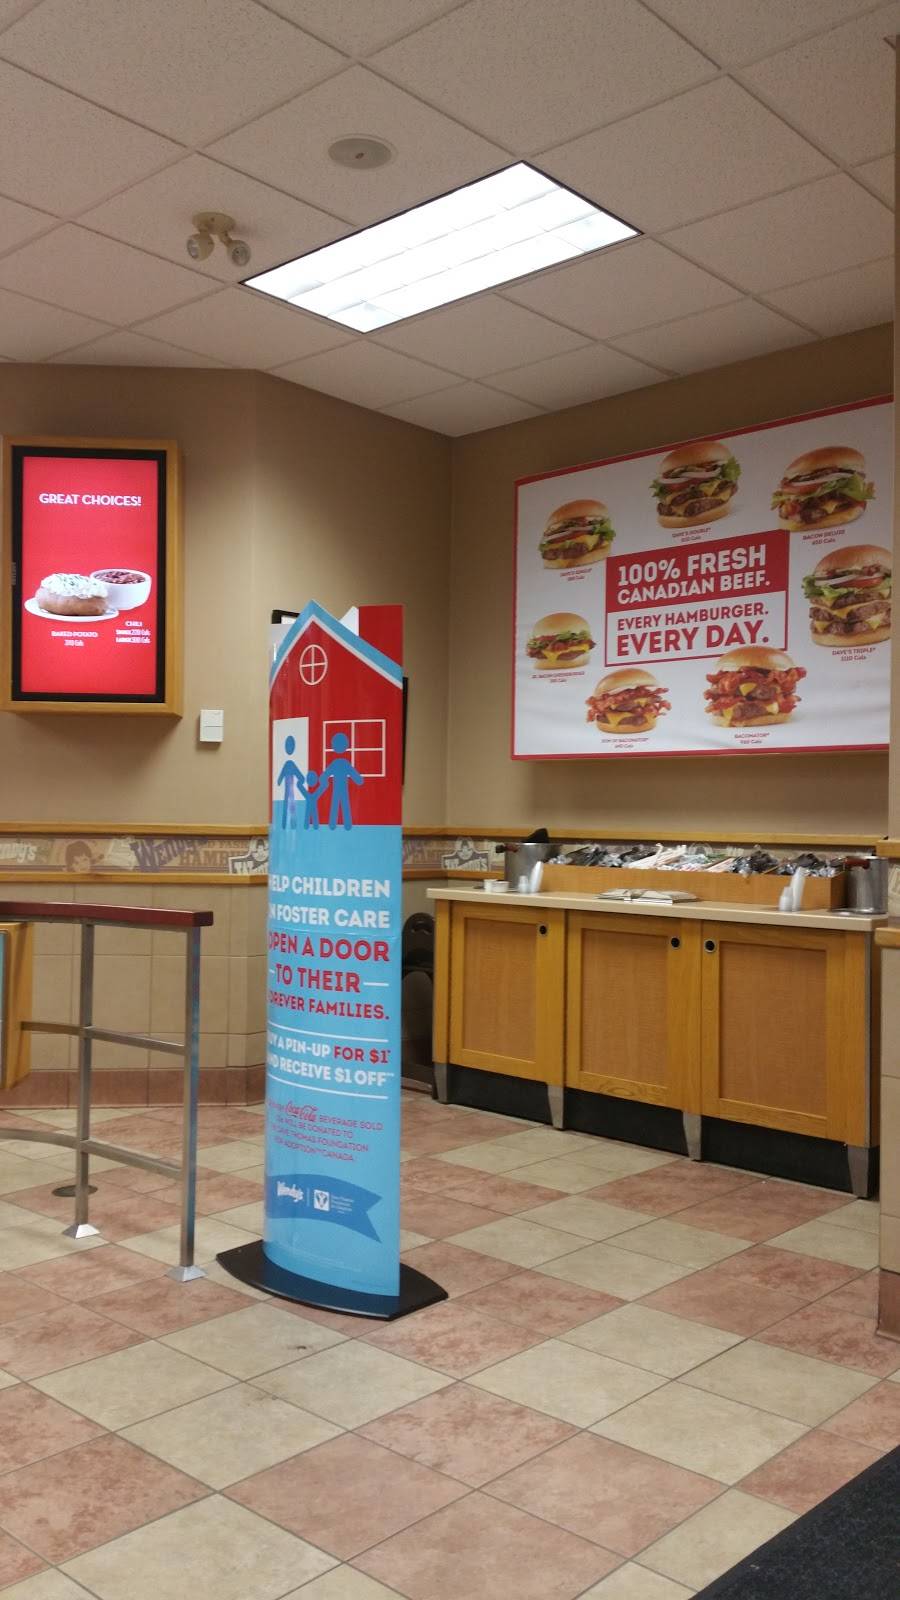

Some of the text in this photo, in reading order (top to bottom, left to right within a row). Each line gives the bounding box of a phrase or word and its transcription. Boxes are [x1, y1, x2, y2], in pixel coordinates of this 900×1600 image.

[39, 493, 142, 507] GREAT CHOICES!
[617, 544, 766, 586] 100% FRESH
[617, 570, 770, 605] CANADIAN BEEF.
[617, 602, 769, 632] EVERY HAMBURGER.
[617, 619, 769, 657] EVERY DAY.
[269, 874, 391, 898] ELP CHILDREN
[277, 904, 330, 926] FOSTER
[334, 909, 390, 929] CARE
[302, 936, 314, 956] A
[319, 937, 390, 962] DOOR
[276, 963, 361, 993] TO THEIR
[308, 998, 390, 1020] FAMILIES.
[277, 1036, 285, 1049] A
[286, 1038, 331, 1057] PIN-UP
[334, 1045, 364, 1062] FOR
[280, 1056, 331, 1081] RECEIVE
[334, 1066, 352, 1083] $1
[360, 1120, 384, 1131] SOLD
